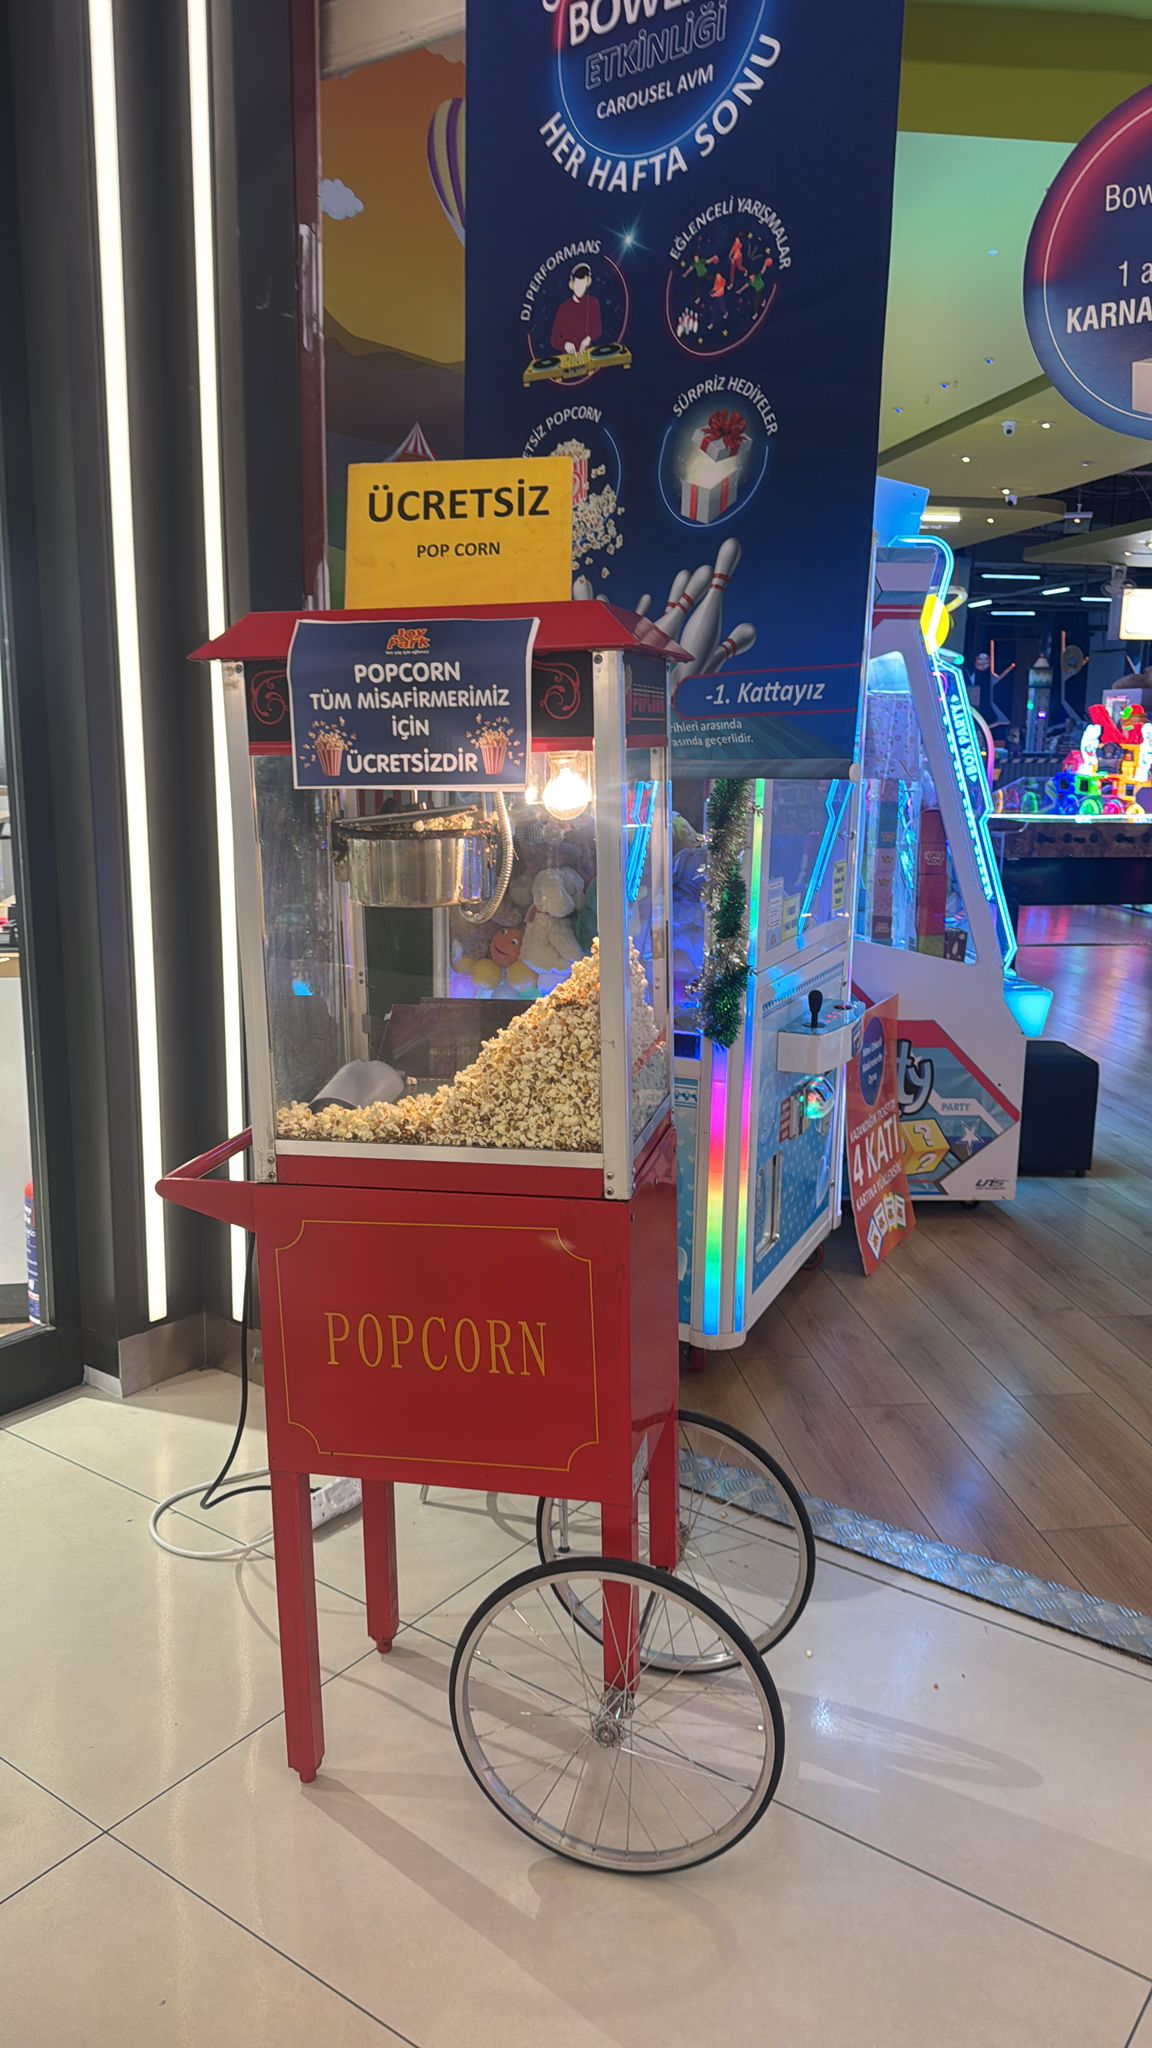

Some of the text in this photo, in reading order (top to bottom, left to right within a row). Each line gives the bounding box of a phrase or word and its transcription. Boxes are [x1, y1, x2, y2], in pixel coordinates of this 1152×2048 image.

[584, 0, 728, 91] ETKİNLİĞİ
[596, 63, 714, 120] CAROUSEL AVM
[539, 33, 783, 193] HER HAFTA SONU
[669, 195, 792, 271] EĞLENCELİ YARIŞMALAR
[520, 239, 602, 321] DJ PERFORMANS
[1118, 260, 1129, 288] 1
[1066, 295, 1152, 335] KARNA
[545, 405, 602, 431] POPCORN
[672, 374, 779, 437] SÜRPRİZ HEDİYELER
[368, 478, 550, 524] ÜCRETSİZ
[416, 541, 501, 558] POP CORN
[386, 635, 431, 651] Park
[353, 661, 461, 684] POPCORN
[308, 684, 511, 711] TÜM MİSAFİRMERİMİZ
[705, 681, 826, 706] -1. Kattayız
[391, 714, 430, 741] İÇİN
[700, 718, 743, 732] arasında
[704, 732, 754, 749] geçerlidir.
[346, 748, 479, 774] ÜCRETSİZDİR
[941, 1102, 970, 1112] PARTY
[853, 1143, 864, 1187] 4
[323, 1311, 548, 1377] POPCORN
